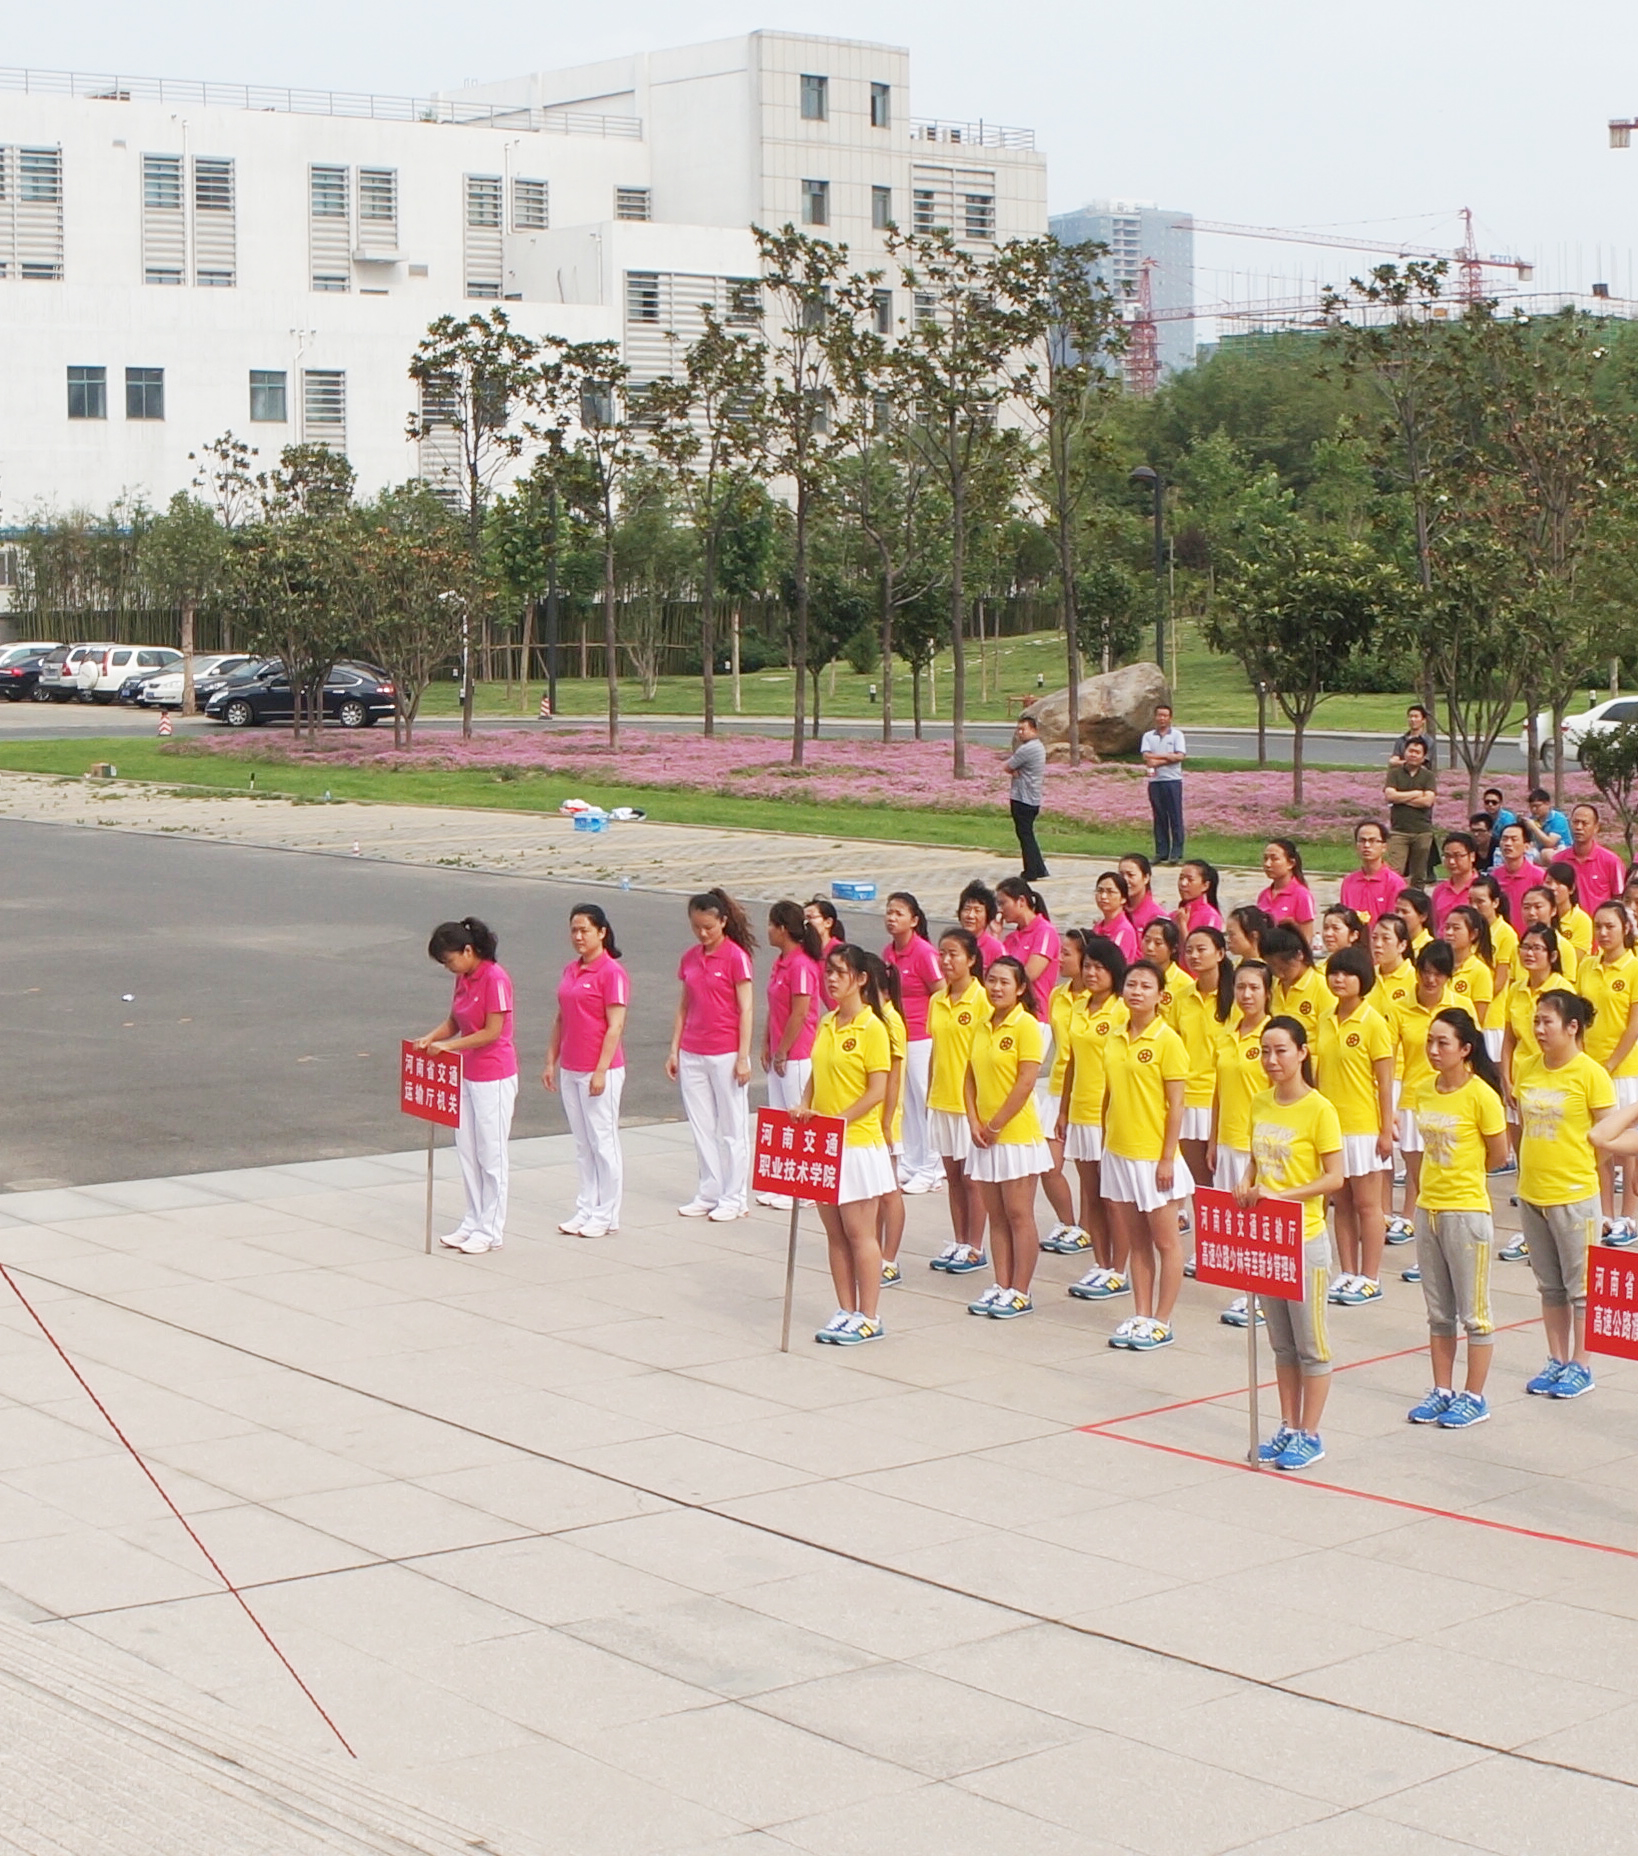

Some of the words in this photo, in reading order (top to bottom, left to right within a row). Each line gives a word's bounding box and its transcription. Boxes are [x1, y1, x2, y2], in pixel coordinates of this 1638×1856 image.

[405, 1053, 458, 1086] 河南省交通
[405, 1081, 458, 1115] 运输厅机关
[761, 1122, 839, 1158] 河南交通
[758, 1154, 837, 1189] 职业技术学院
[1200, 1205, 1297, 1246] 河南省交通运输厅
